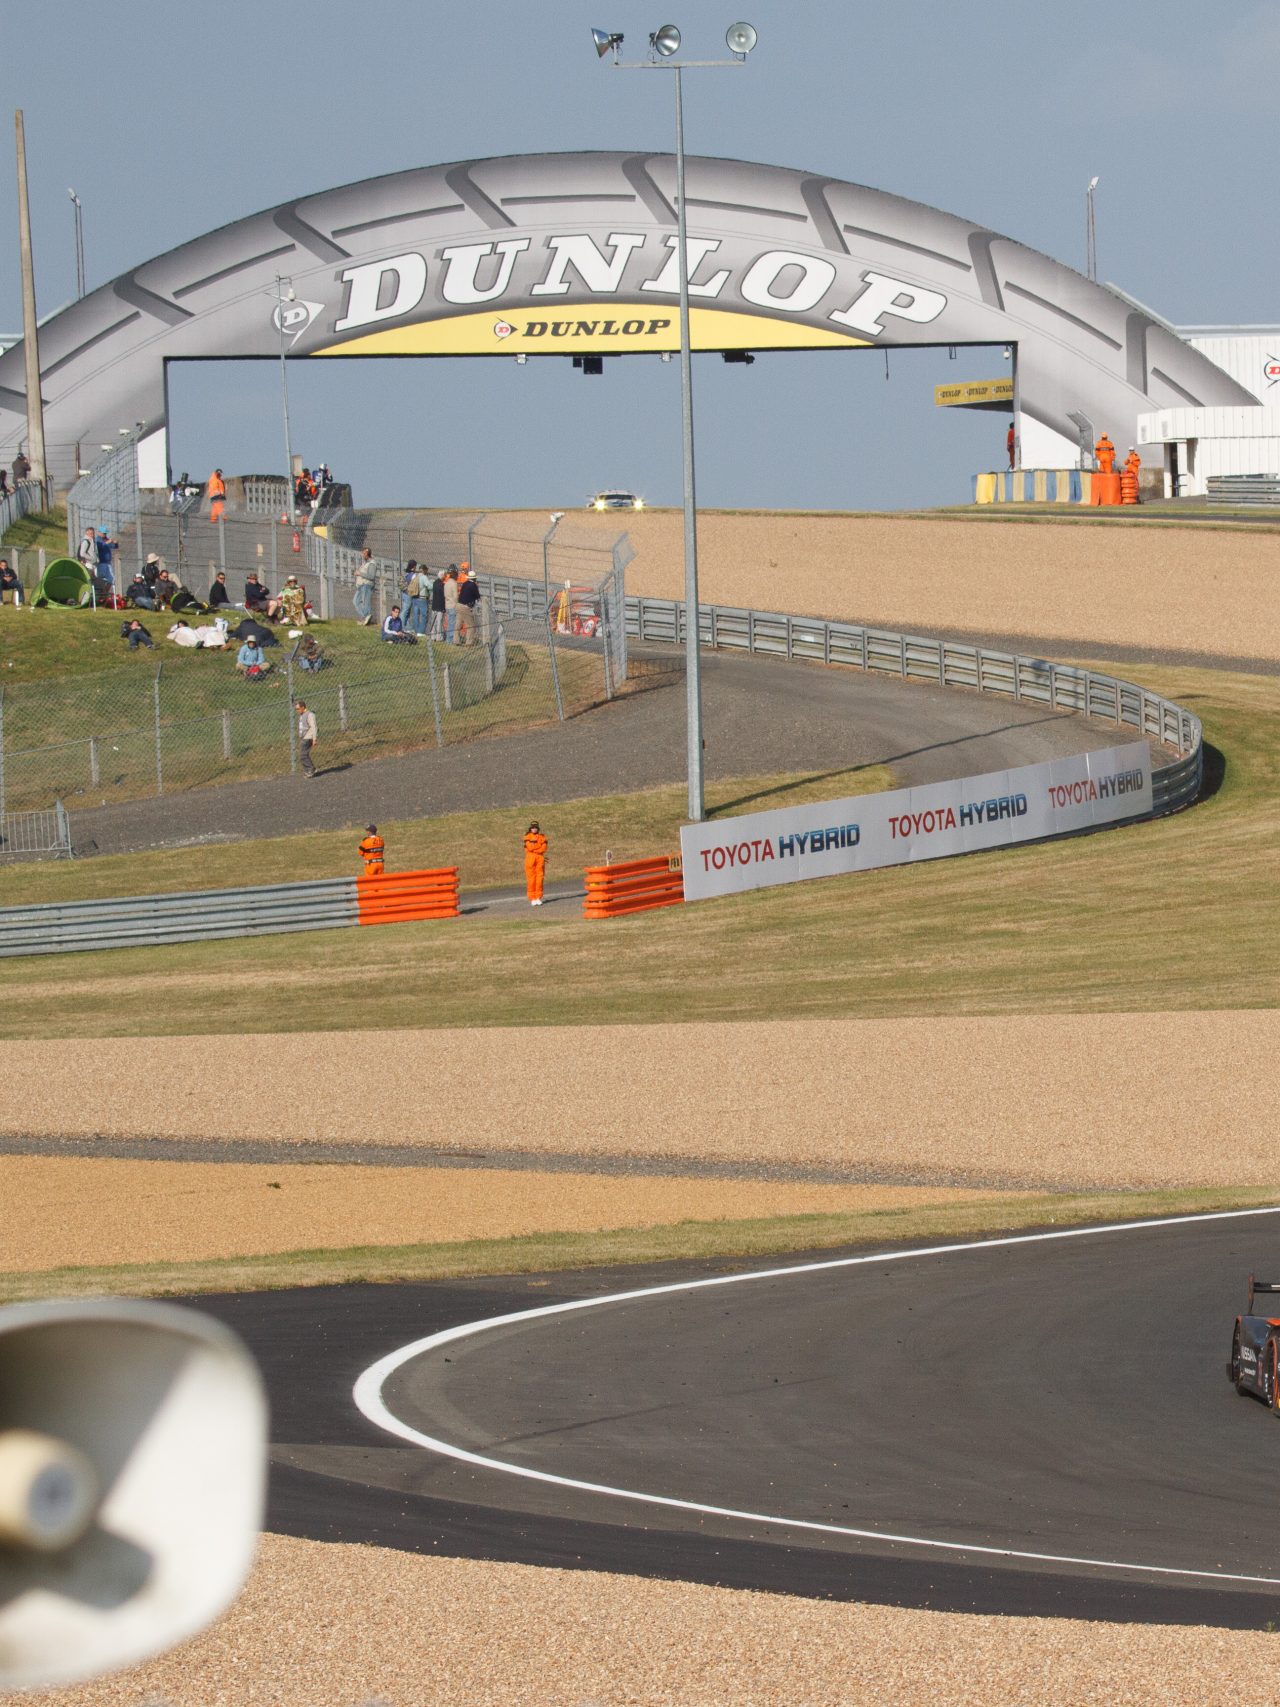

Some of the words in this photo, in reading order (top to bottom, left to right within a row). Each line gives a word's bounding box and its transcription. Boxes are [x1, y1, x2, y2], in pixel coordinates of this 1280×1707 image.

[334, 231, 948, 337] DUNLOP
[522, 319, 671, 337] DUNLOP
[995, 385, 1014, 394] DUNLO
[1048, 779, 1098, 808] TOYOTA
[1098, 768, 1143, 799] HYBRID
[888, 807, 957, 839] TOYOTA
[959, 793, 1028, 827] HYBRID
[700, 838, 775, 872] TOYOTA
[778, 823, 860, 858] HYBRID
